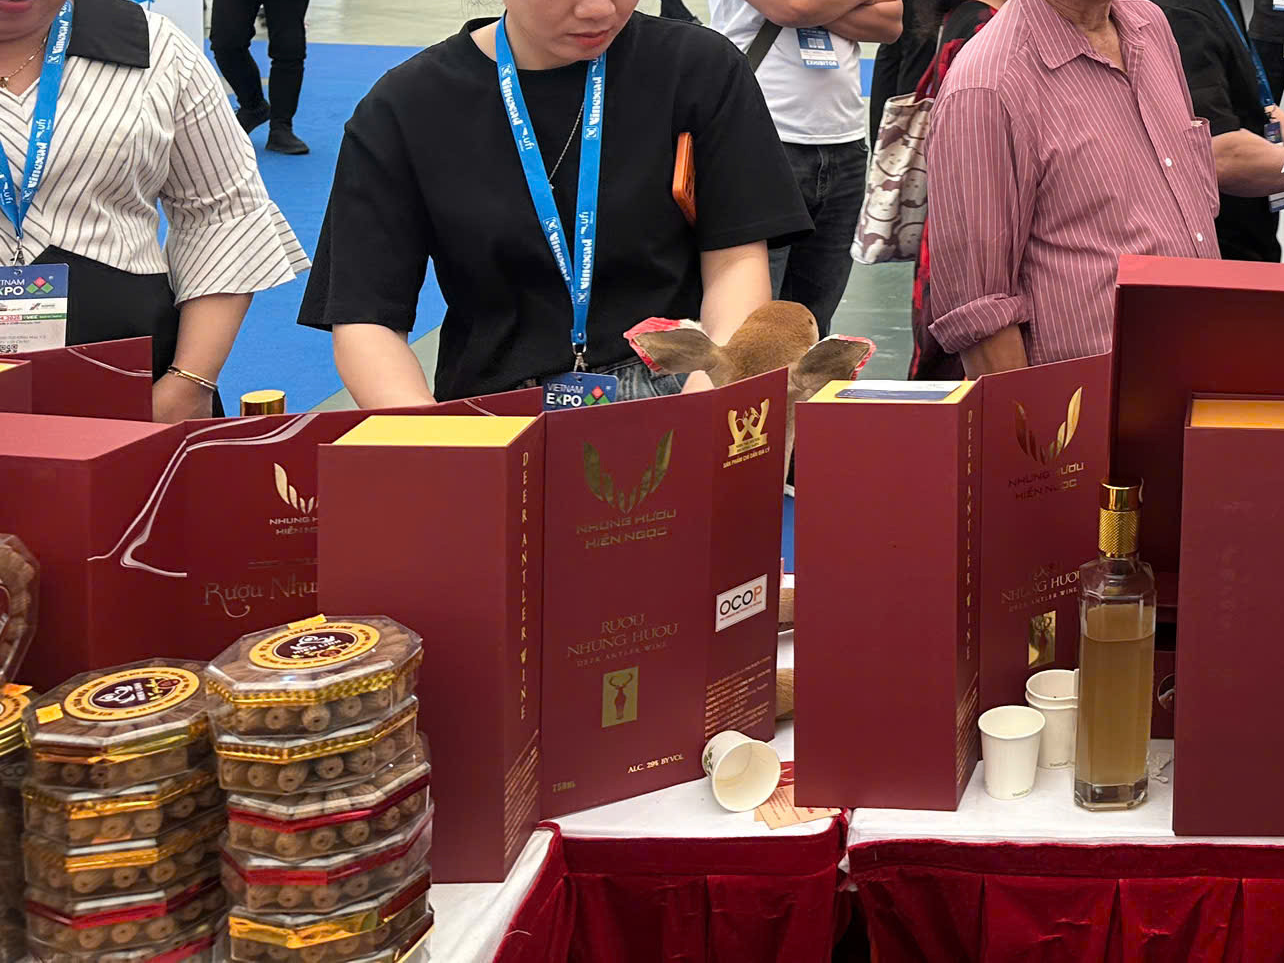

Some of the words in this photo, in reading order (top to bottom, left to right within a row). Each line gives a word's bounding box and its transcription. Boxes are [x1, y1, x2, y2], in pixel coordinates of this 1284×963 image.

[501, 76, 524, 126] Vinexad
[589, 76, 603, 126] Vinexad
[28, 142, 48, 189] Vinexad
[580, 238, 593, 289] Vinexad
[0, 286, 25, 296] XPO
[546, 393, 583, 407] EXPO
[547, 383, 584, 394] VIETNAM
[521, 451, 529, 523] DEER
[269, 516, 310, 525] NHUNG
[575, 516, 633, 535] NHUNG
[269, 574, 319, 600] Nhu
[520, 533, 528, 641] ANTLER
[719, 584, 763, 616] OCOP
[567, 633, 627, 659] NHUNG
[520, 647, 528, 721] WINE
